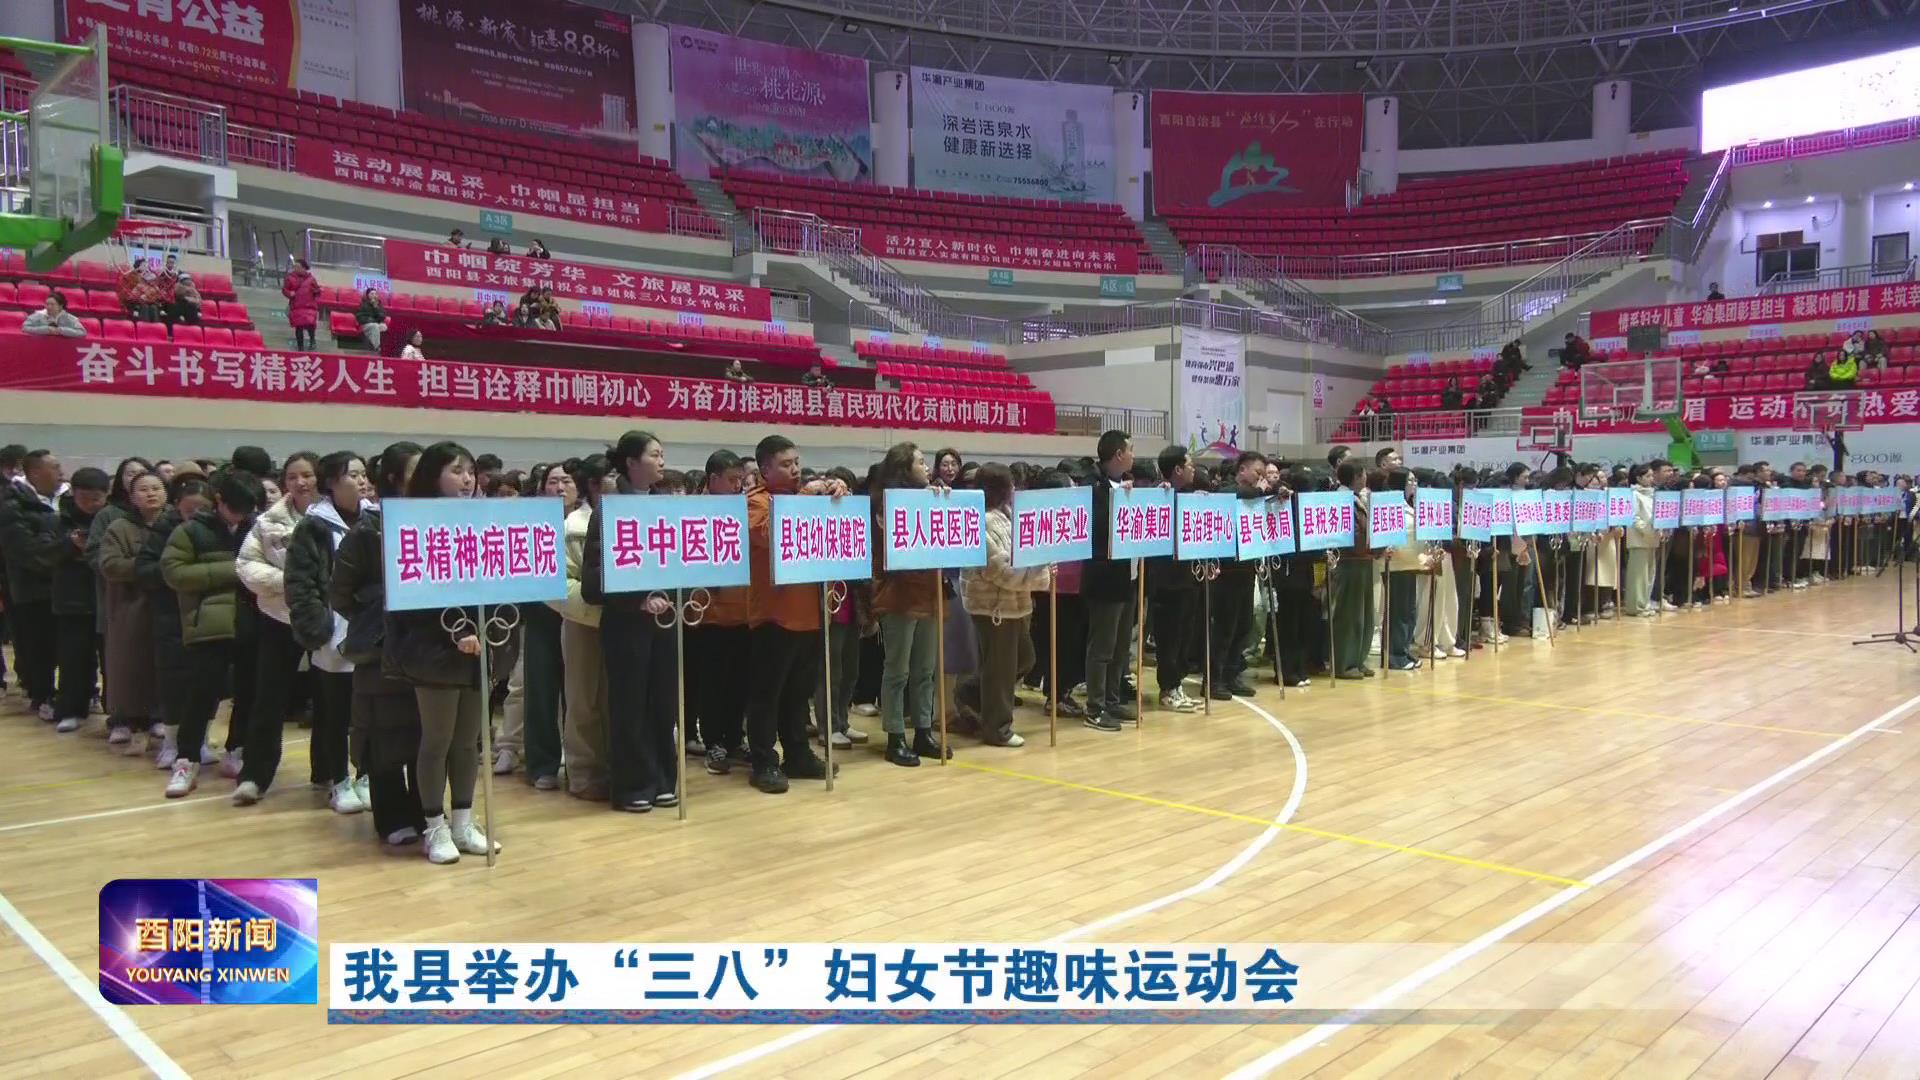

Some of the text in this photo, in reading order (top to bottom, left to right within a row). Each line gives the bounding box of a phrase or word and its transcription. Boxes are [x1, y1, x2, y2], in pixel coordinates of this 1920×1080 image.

[942, 113, 1032, 140] 深岩活泉水
[943, 135, 1033, 161] 健康新选择
[332, 150, 641, 216] 运动展风采 巾帼显担当
[886, 234, 1117, 263] 活力宜人新时代 巾帼奋进向未来
[423, 249, 745, 302] 巾帼绽芳华 文旅展风采
[1792, 288, 1871, 318] 凝聚巾帼力量
[75, 342, 1029, 427] 奋斗书写精彩人生 担当诠释巾帼初心 为奋力推动强县富民现代化贡献巾帼力量!
[891, 506, 981, 548] 县人民医院
[1018, 504, 1089, 549] 酉州实业
[1115, 503, 1172, 544] 华渝集团
[1181, 509, 1234, 544] 县治理中心
[1239, 507, 1292, 545] 县气象局
[1302, 504, 1353, 537] 县税务局
[1372, 505, 1405, 534] 县医保局
[1417, 501, 1451, 529] 县林业局
[397, 524, 558, 583] 县精神病医院
[612, 516, 742, 568] 县中医院
[779, 515, 867, 562] 县妇幼保健院
